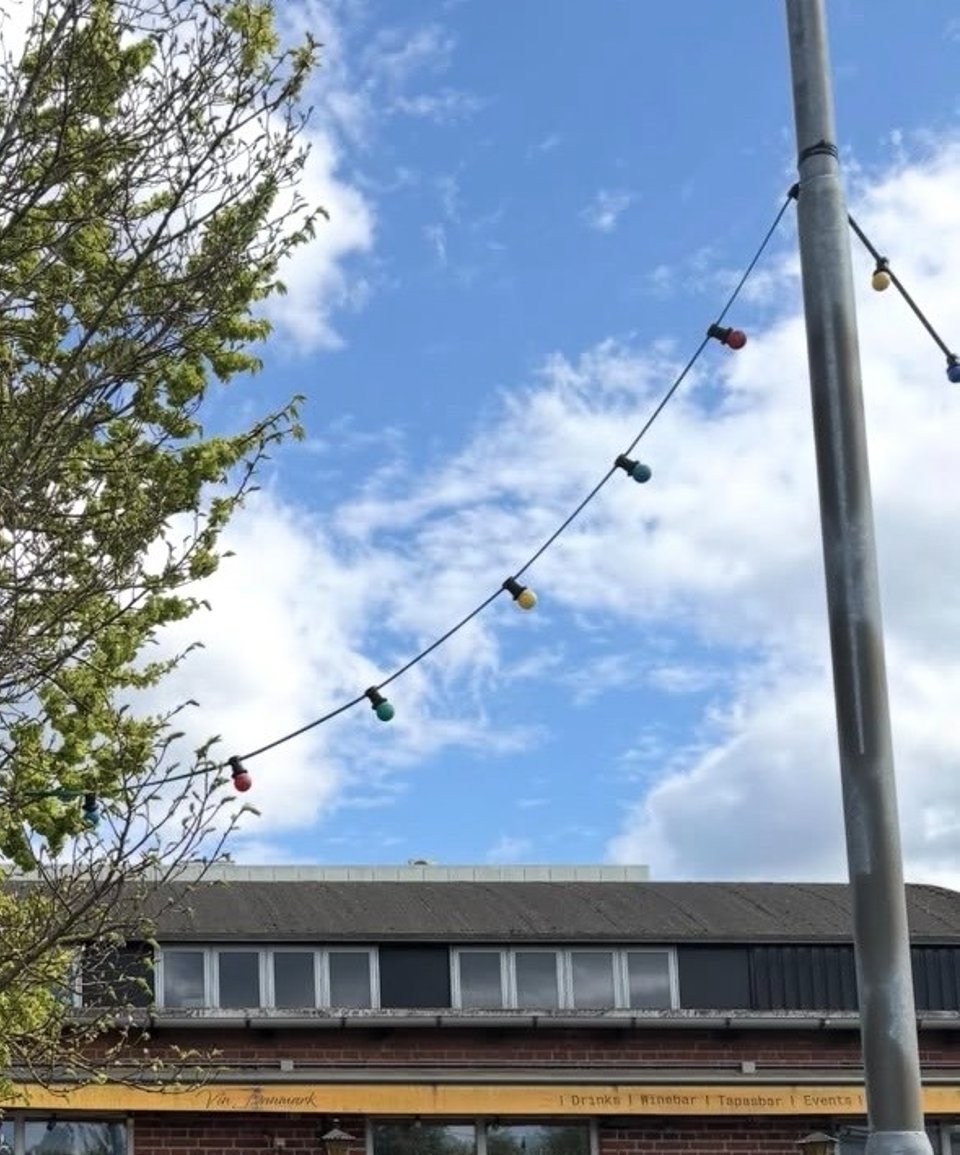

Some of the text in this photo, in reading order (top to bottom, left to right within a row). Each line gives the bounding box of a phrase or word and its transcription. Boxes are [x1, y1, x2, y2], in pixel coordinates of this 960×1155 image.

[571, 1094, 852, 1108] Drinks Winebar Tapasbar Events
